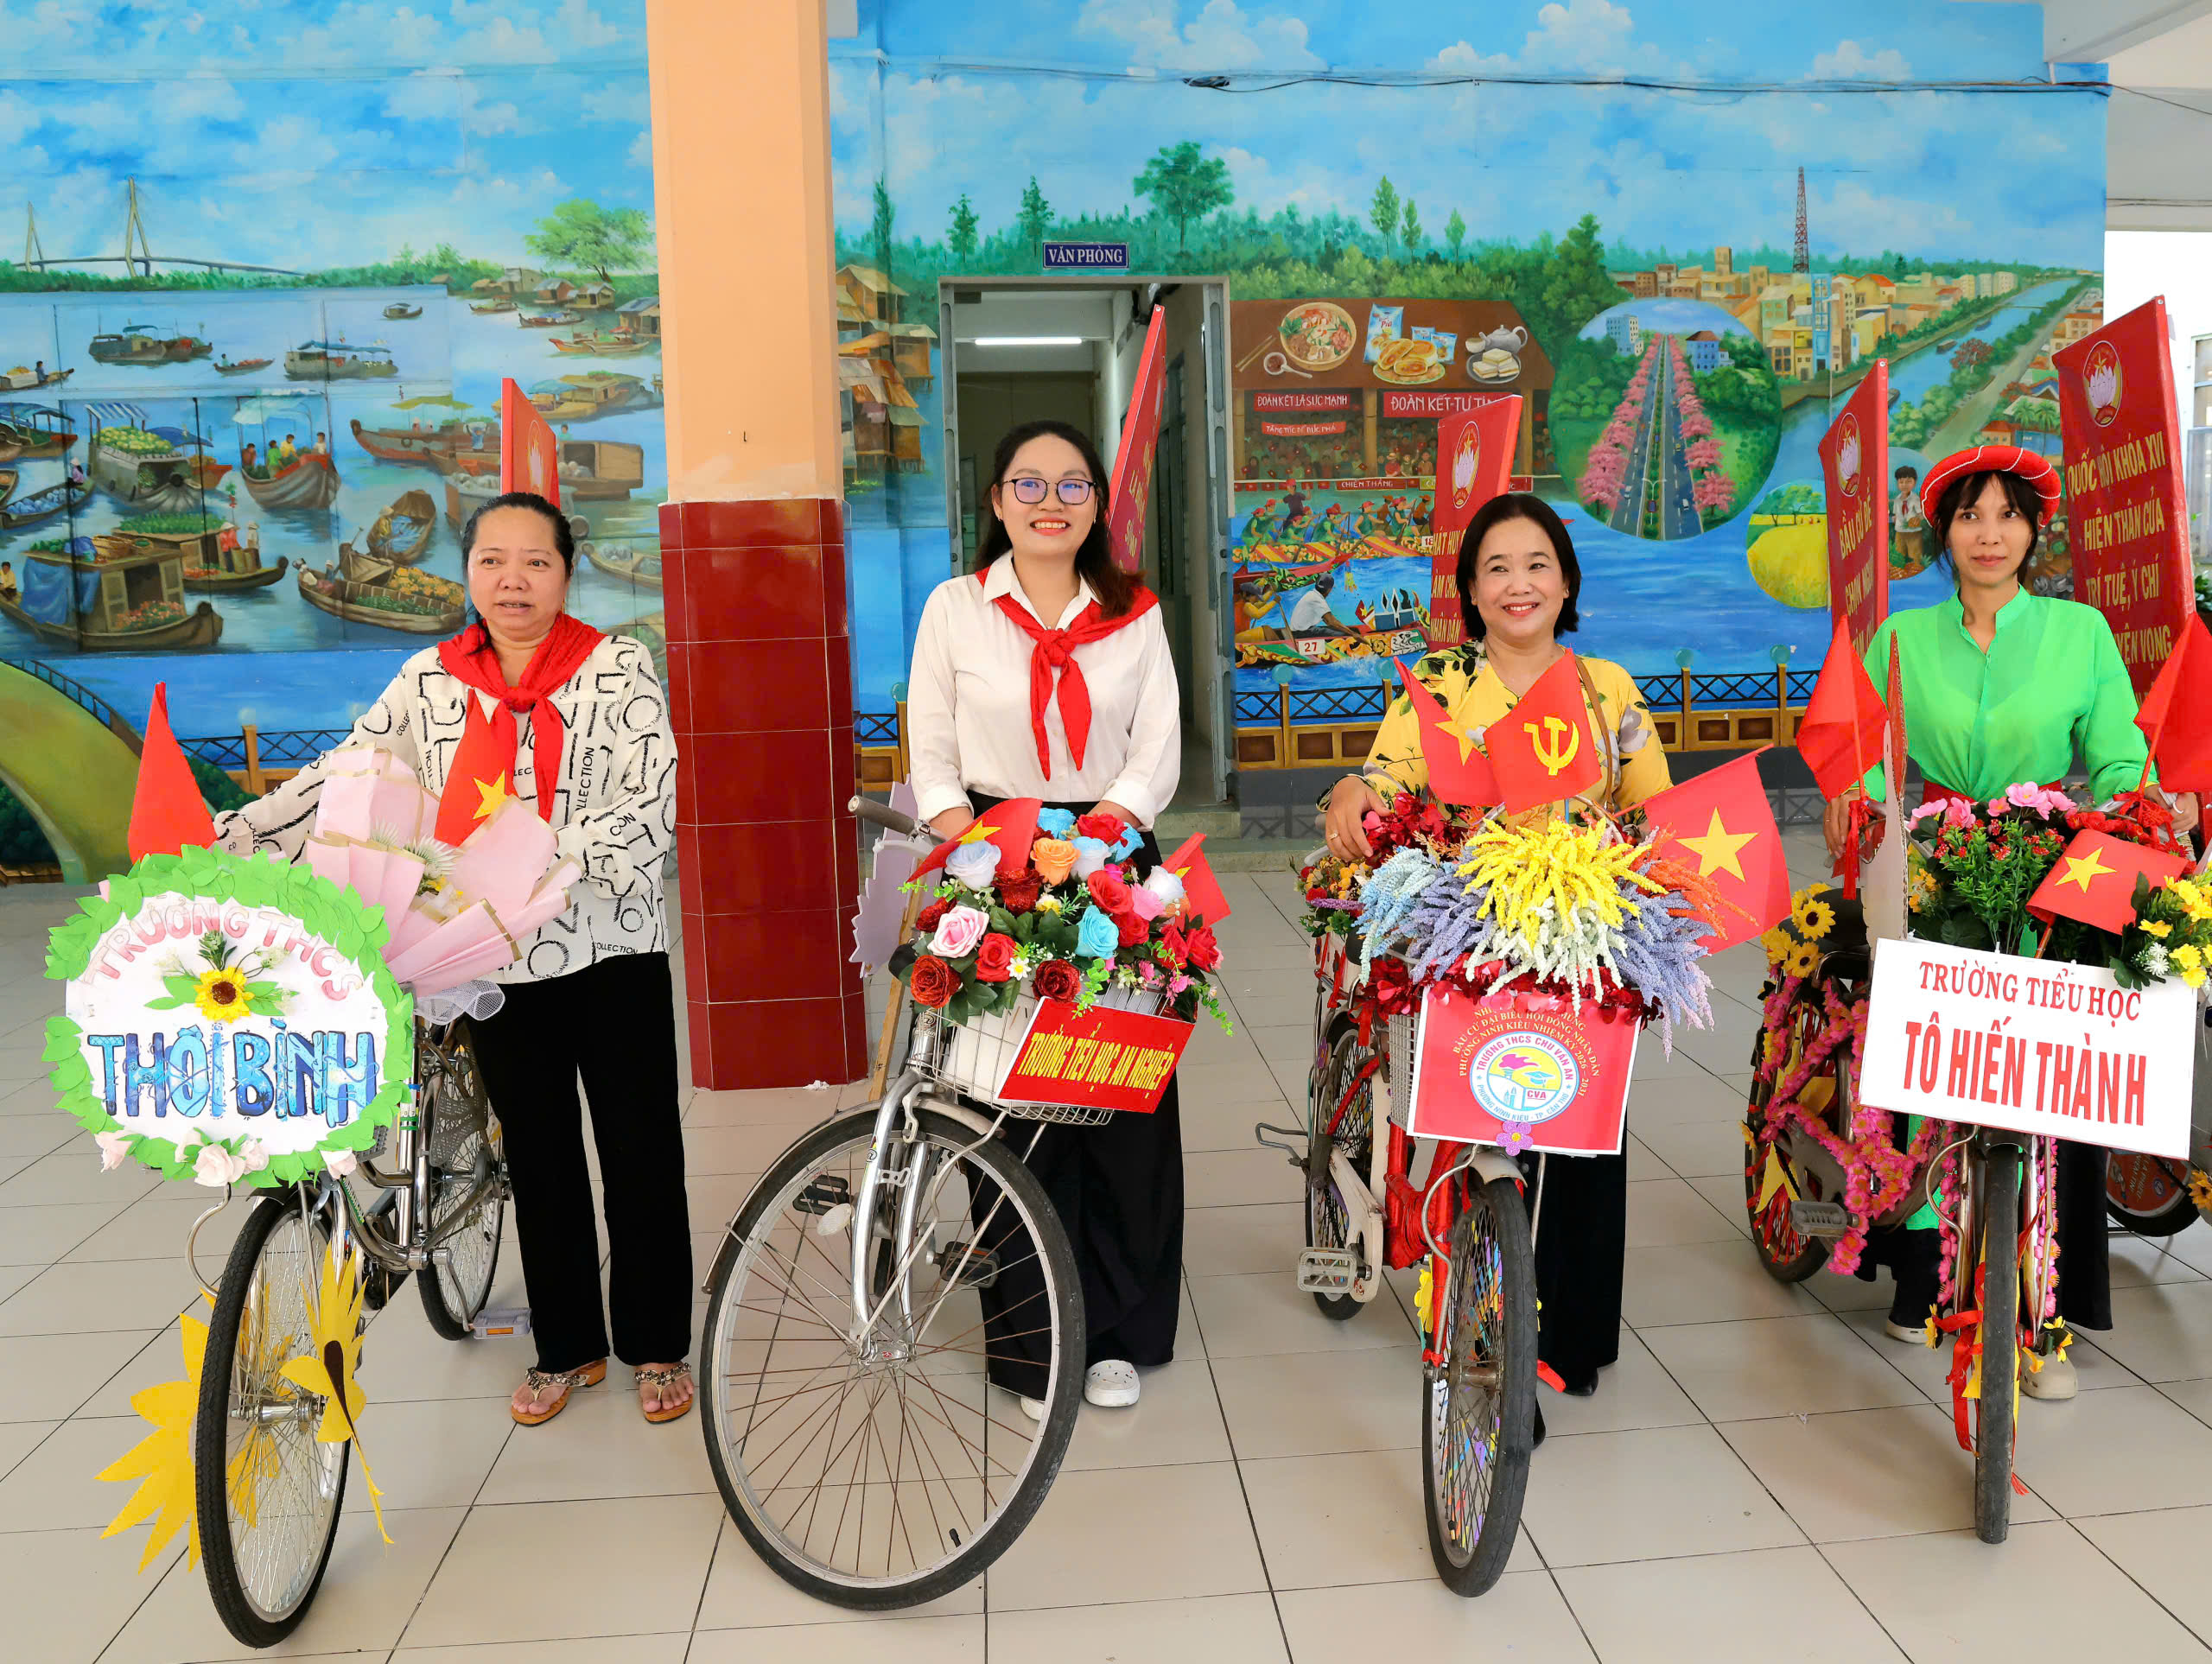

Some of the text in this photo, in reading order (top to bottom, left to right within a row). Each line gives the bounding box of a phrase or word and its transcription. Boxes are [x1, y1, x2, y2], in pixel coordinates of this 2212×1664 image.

[1048, 245, 1122, 263] VĂN PHÒNG
[1324, 395, 1348, 408] MẠNH
[1390, 394, 1426, 411] ĐOÀN
[2068, 447, 2097, 501] QUỐC
[2113, 432, 2147, 482] KHÓA
[2145, 430, 2166, 470] XVI
[1839, 509, 1857, 560] BẦU
[2084, 486, 2165, 556] HIỆN THÂN CỦA
[2086, 567, 2102, 609] TRÍ
[2132, 559, 2139, 602] Ý
[2141, 553, 2159, 600] CHÍ
[1304, 641, 1318, 653] 27
[2140, 624, 2172, 670] VỌNG
[257, 911, 364, 1001] THCS
[1919, 959, 2141, 1027] TRƯỜNG TIỂU HỌC
[1452, 1033, 1468, 1054] BẦU
[1481, 1014, 1499, 1027] ĐẠI
[1526, 1013, 1544, 1022] HỘI
[1573, 1032, 1593, 1055] NHÂN
[1479, 1024, 1504, 1038] NINH
[1506, 1019, 1530, 1030] KIỀU
[1533, 1023, 1565, 1041] NHIỆM
[232, 1016, 380, 1128] BÌNH
[1016, 1022, 1176, 1100] TRƯỜNG TIỂU HỌC AN NGHIỆP
[1459, 1037, 1480, 1077] PHƯỜNG
[1505, 1035, 1532, 1045] THCS
[1535, 1037, 1555, 1051] CHU
[1564, 1068, 1573, 1080] AN
[1574, 1051, 1587, 1070] 2026
[1903, 1011, 2147, 1127] TÔ HIẾN THÀNH
[1527, 1089, 1547, 1099] CVA
[1578, 1077, 1589, 1097] 2031
[1494, 1106, 1511, 1119] NINH
